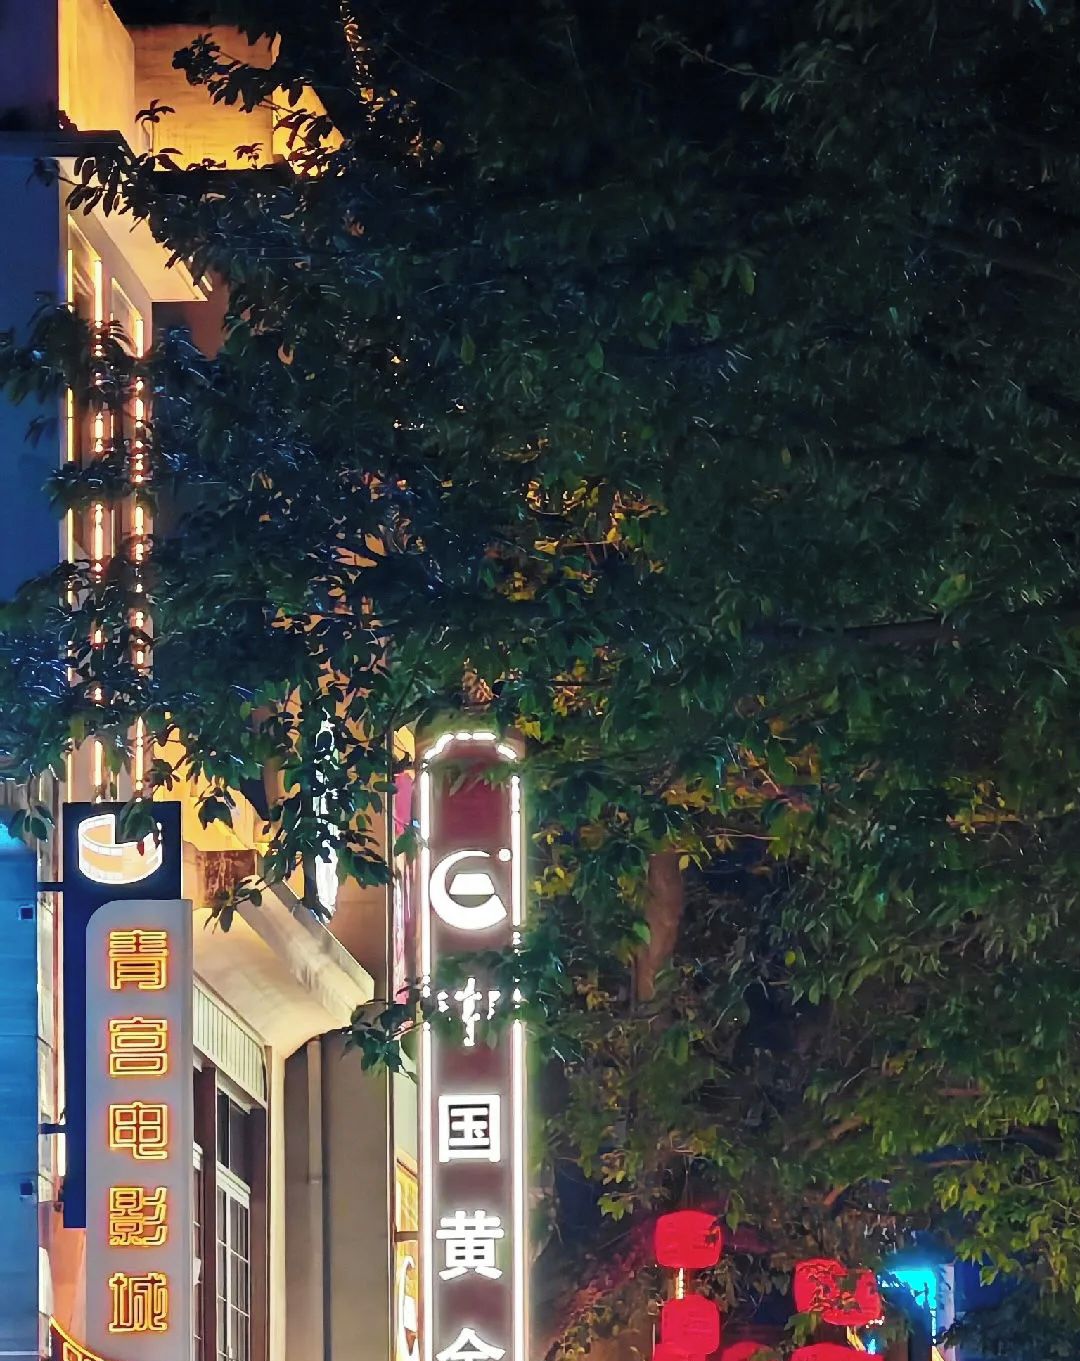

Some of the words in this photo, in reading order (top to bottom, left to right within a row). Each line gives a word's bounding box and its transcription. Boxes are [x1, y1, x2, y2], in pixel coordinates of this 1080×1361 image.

[107, 929, 169, 1333] 青宫电影城
